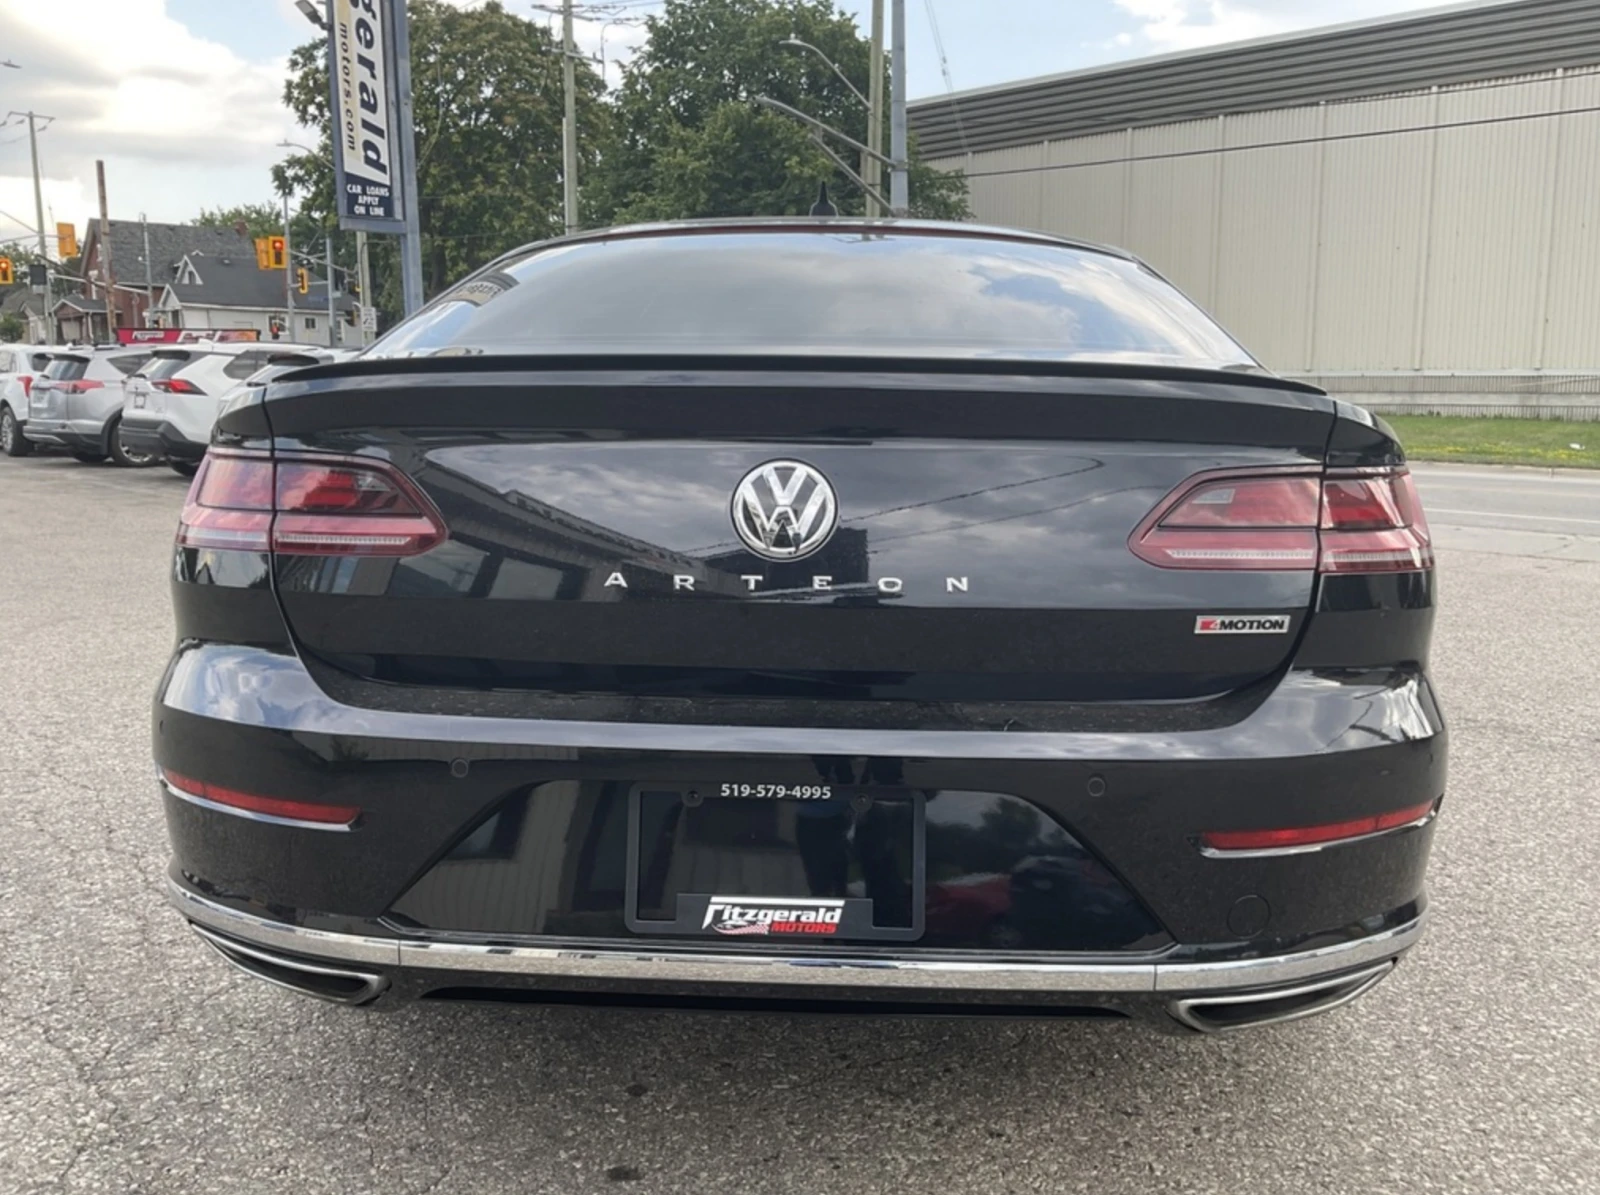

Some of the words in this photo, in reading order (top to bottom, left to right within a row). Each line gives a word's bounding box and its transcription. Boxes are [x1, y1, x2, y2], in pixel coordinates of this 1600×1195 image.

[340, 22, 356, 151] motors.com
[346, 184, 362, 194] CAR
[366, 186, 390, 197] LOANS
[357, 195, 380, 205] APPLY
[353, 205, 366, 215] ON
[369, 206, 385, 216] LINE
[604, 572, 969, 593] ARTEON
[720, 783, 832, 800] 519-579-4995
[701, 898, 845, 929] Fitzgerald
[771, 920, 837, 934] MOTORS
